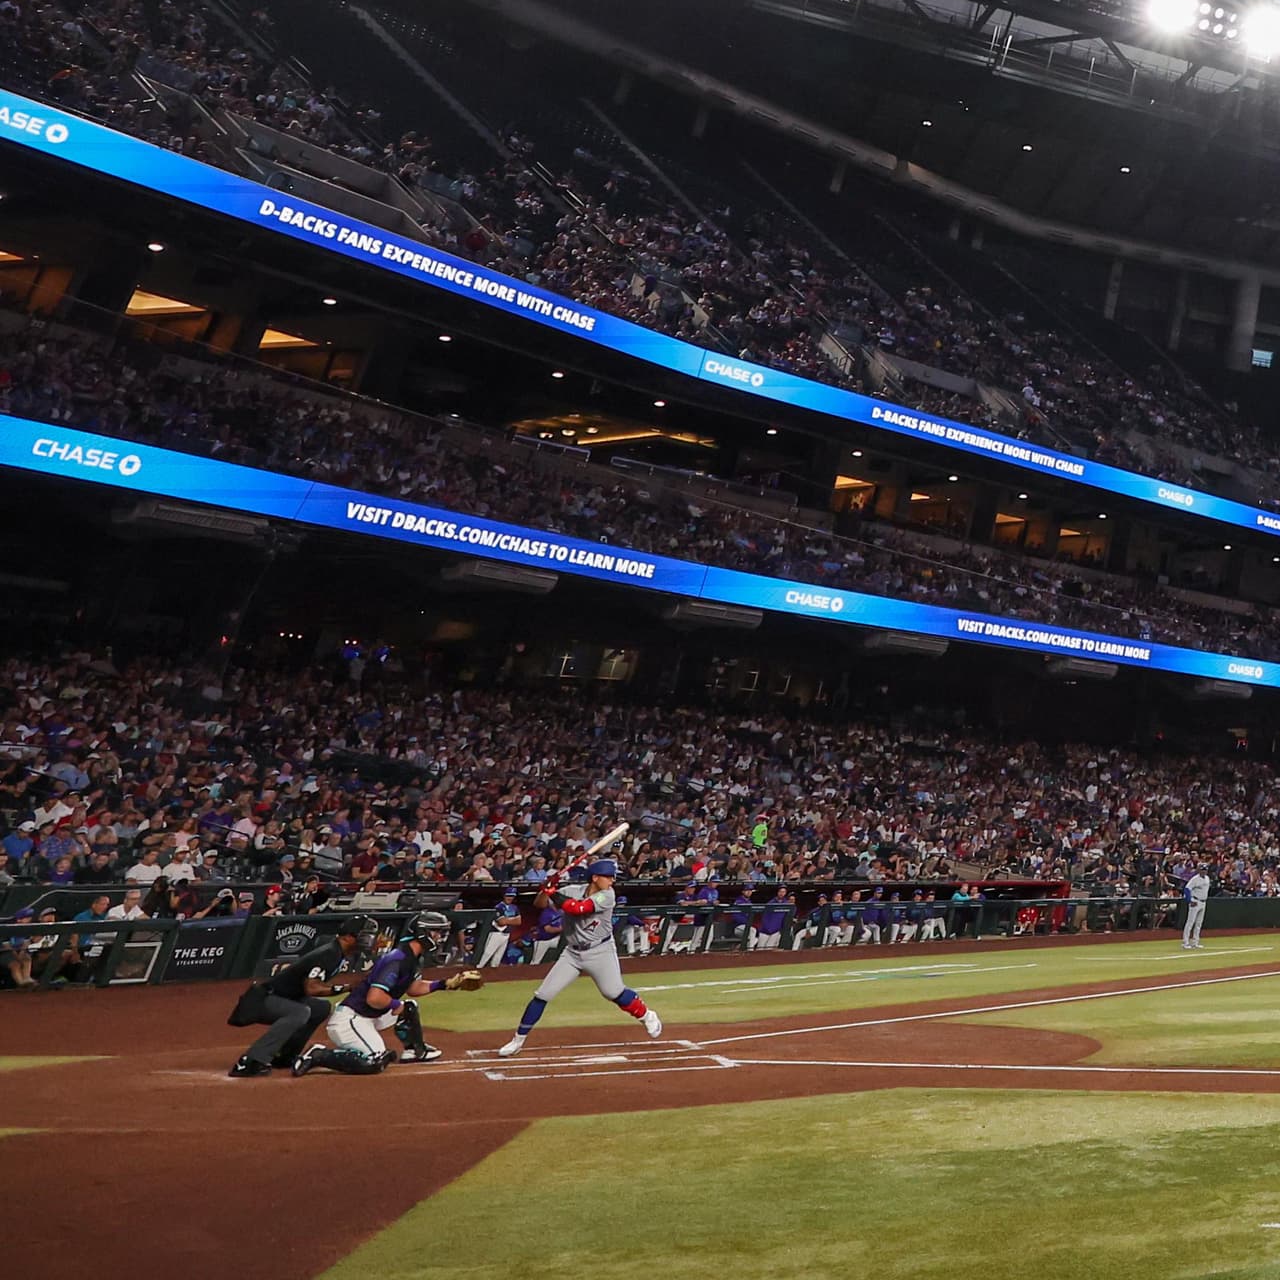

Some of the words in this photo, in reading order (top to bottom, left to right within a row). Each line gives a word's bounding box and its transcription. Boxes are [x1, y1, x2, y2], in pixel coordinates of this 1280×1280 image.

[259, 199, 336, 239] D-BACKS
[337, 227, 381, 255] FANS
[382, 242, 472, 286] EXPERIENCE
[472, 277, 515, 301] MORE
[515, 291, 552, 316] WITH
[552, 303, 596, 332] CHASE
[705, 359, 751, 384] CHASE
[31, 438, 119, 471] CHASE
[872, 406, 918, 432] D-BACKS
[918, 420, 946, 440] FANS
[946, 428, 1003, 455] EXPERIENCE
[1003, 442, 1031, 463] MORE
[1031, 450, 1056, 468] WITH
[1055, 456, 1084, 475] CHASE
[1158, 488, 1185, 504] CHASE
[346, 502, 392, 526] VISIT
[392, 511, 548, 560] DBACKS.COM/CHASE
[549, 544, 569, 561] TO
[569, 549, 614, 570] LEARN
[614, 556, 654, 579] MORE
[786, 589, 830, 610] CHASE
[958, 618, 985, 636] VISIT
[985, 623, 1081, 650] DBACKS.COM/CHASE
[1082, 639, 1094, 651] TO
[1095, 640, 1124, 657] LEARN
[1124, 645, 1150, 660] MORE
[174, 948, 197, 959] THE
[200, 946, 224, 957] KEG
[308, 968, 326, 980] 64
